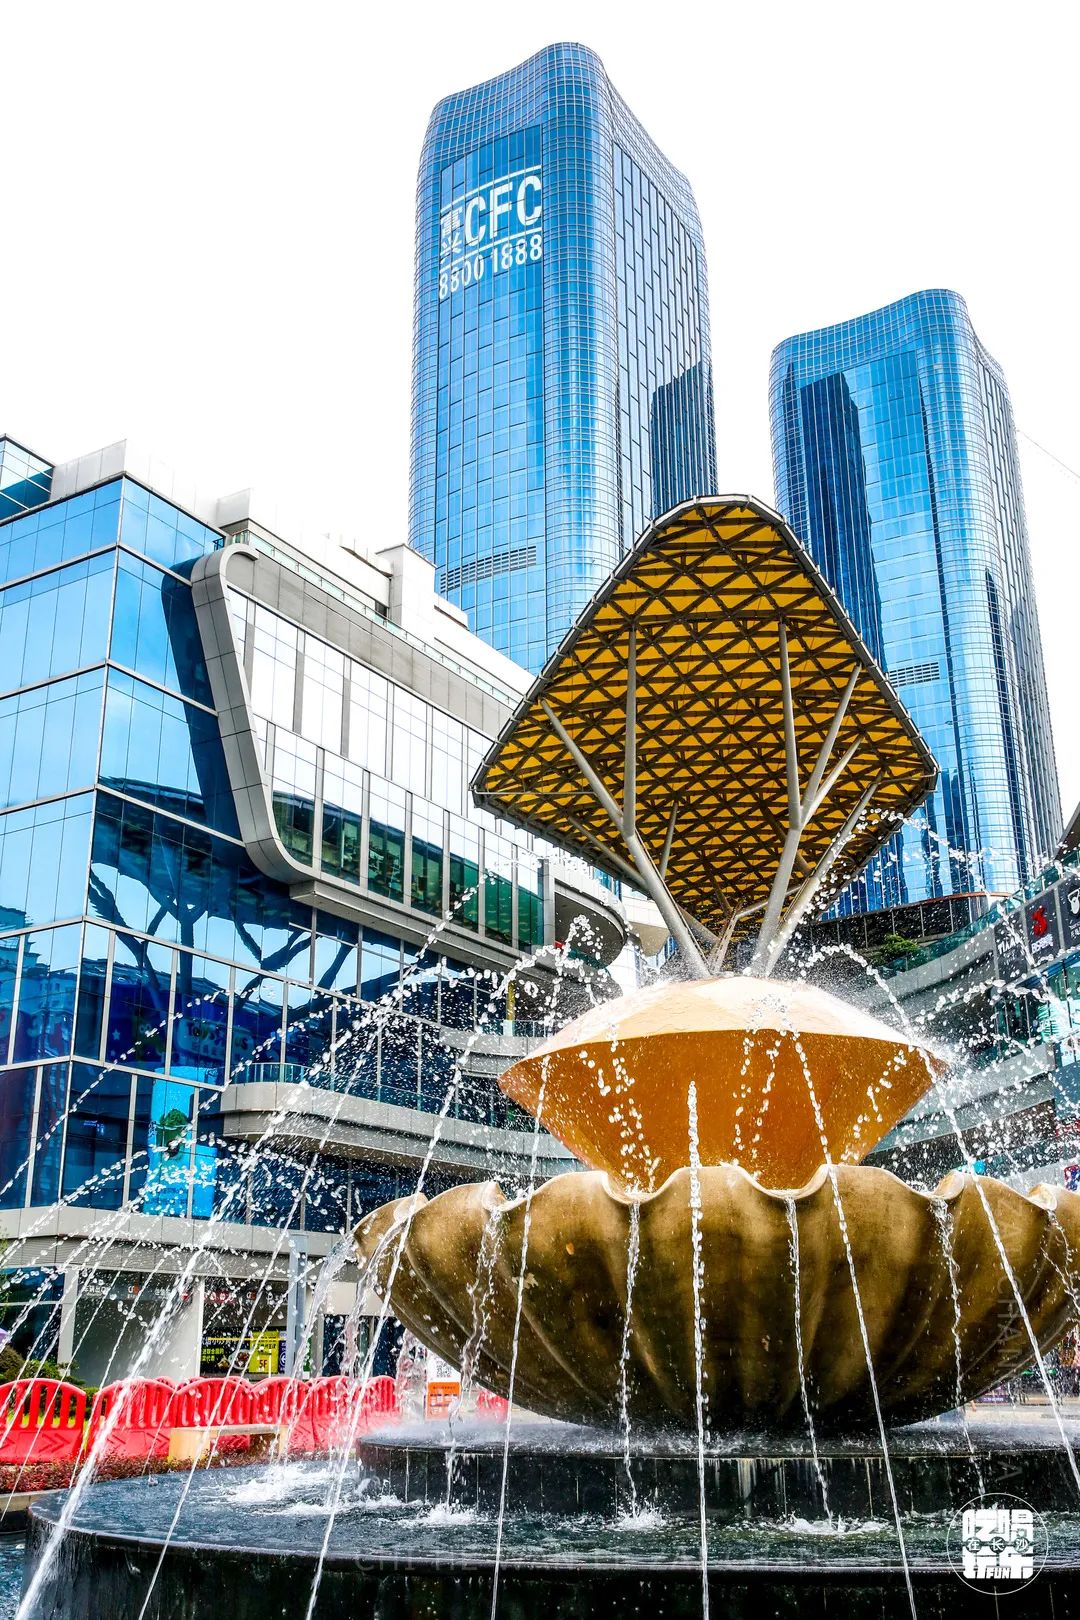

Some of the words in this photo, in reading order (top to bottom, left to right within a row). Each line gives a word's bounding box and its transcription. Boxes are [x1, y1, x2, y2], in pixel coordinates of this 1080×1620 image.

[464, 174, 542, 247] CFC
[439, 254, 485, 300] 8800
[490, 234, 542, 274] 1888
